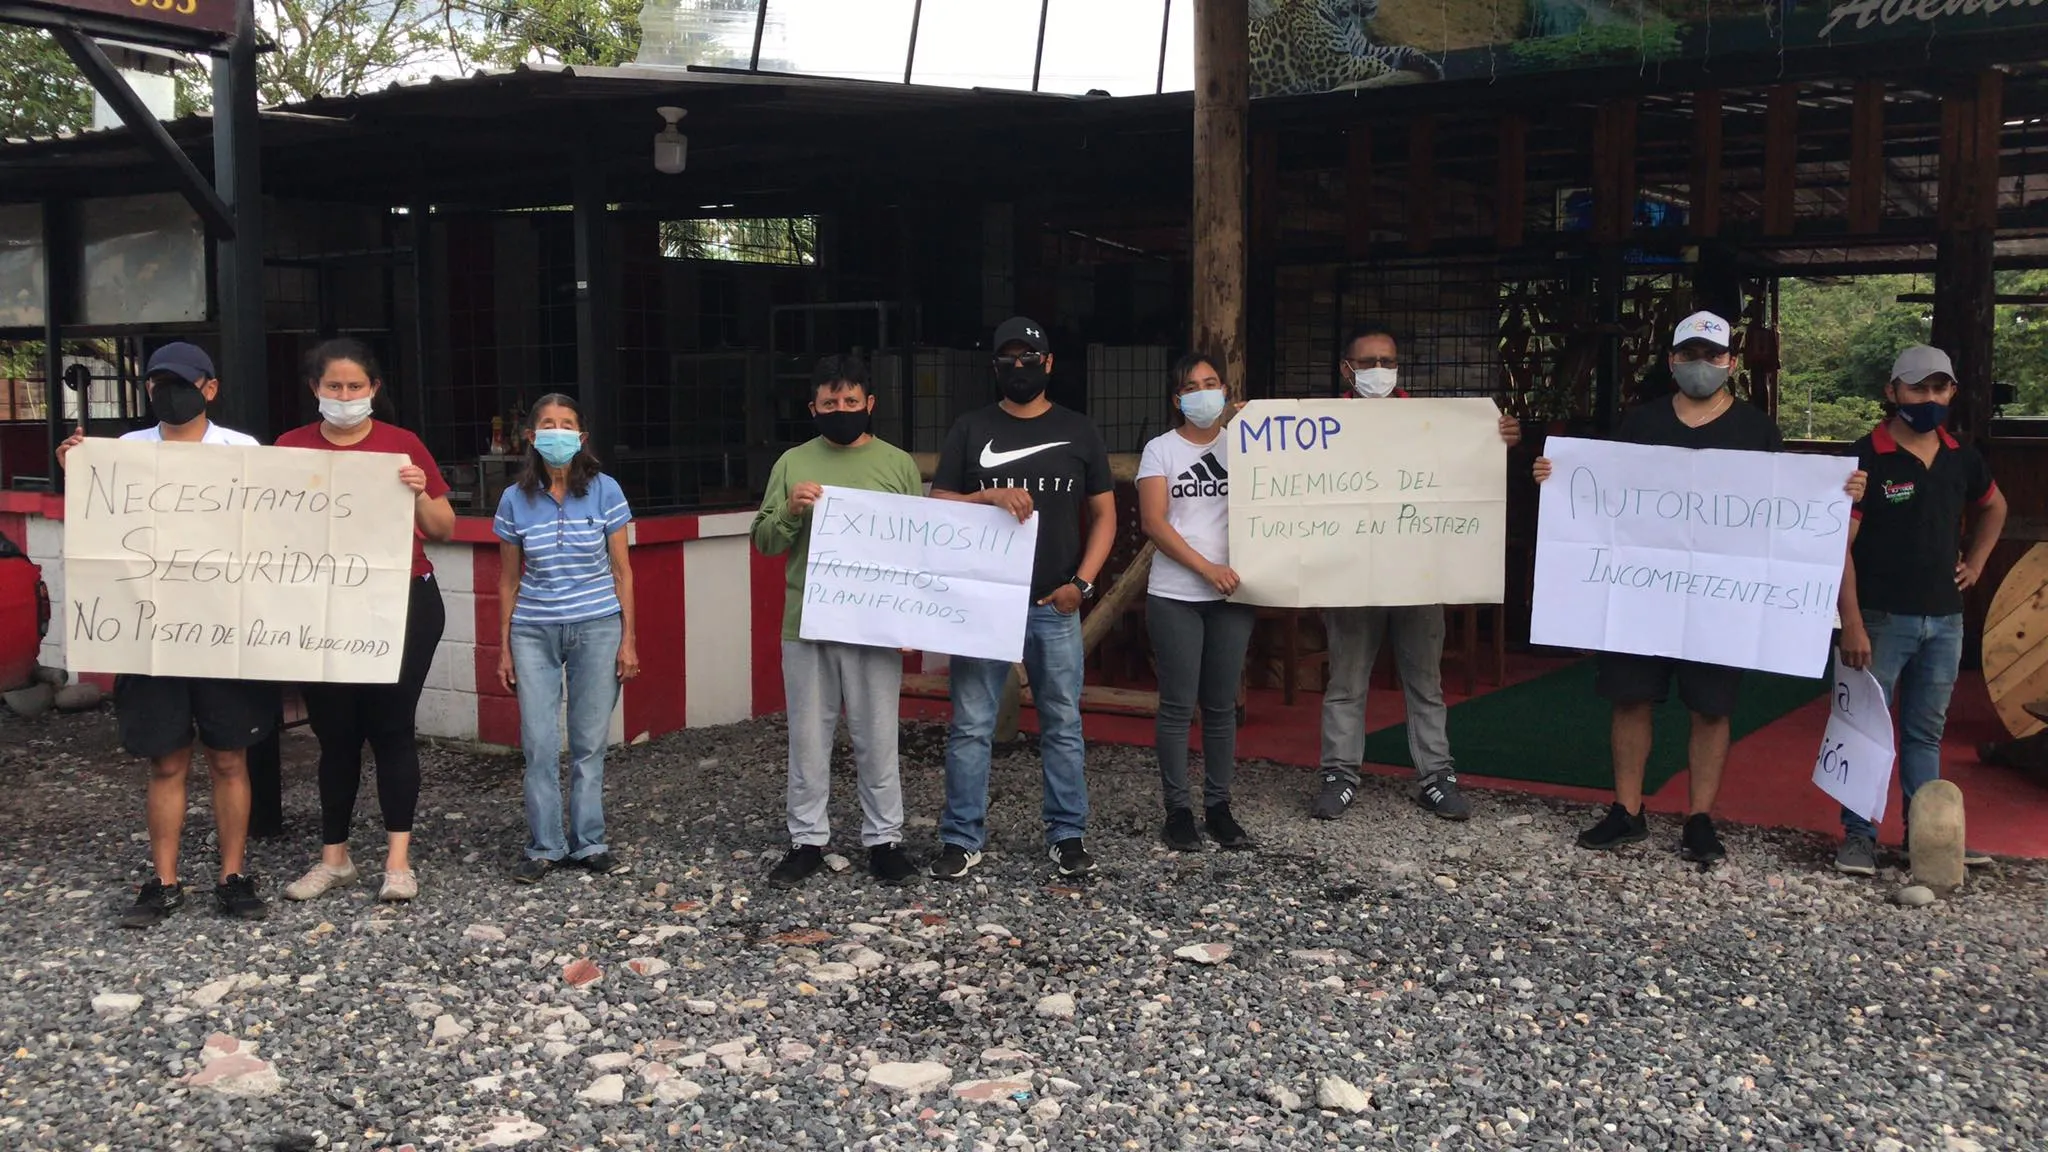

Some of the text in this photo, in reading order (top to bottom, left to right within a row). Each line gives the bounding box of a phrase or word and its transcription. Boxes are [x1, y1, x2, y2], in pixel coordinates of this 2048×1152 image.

[1239, 415, 1341, 453] MTOP
[1251, 466, 1442, 501] ENEMIGOS DEL
[1570, 466, 1841, 537] AUTORIDADES
[1247, 503, 1480, 540] TURISMO EN PASTAZA
[807, 582, 969, 624] PLANIFICADOS
[74, 596, 390, 657] NO PISTA DE ALTA VELOCIDAD
[1817, 738, 1848, 785] ión
